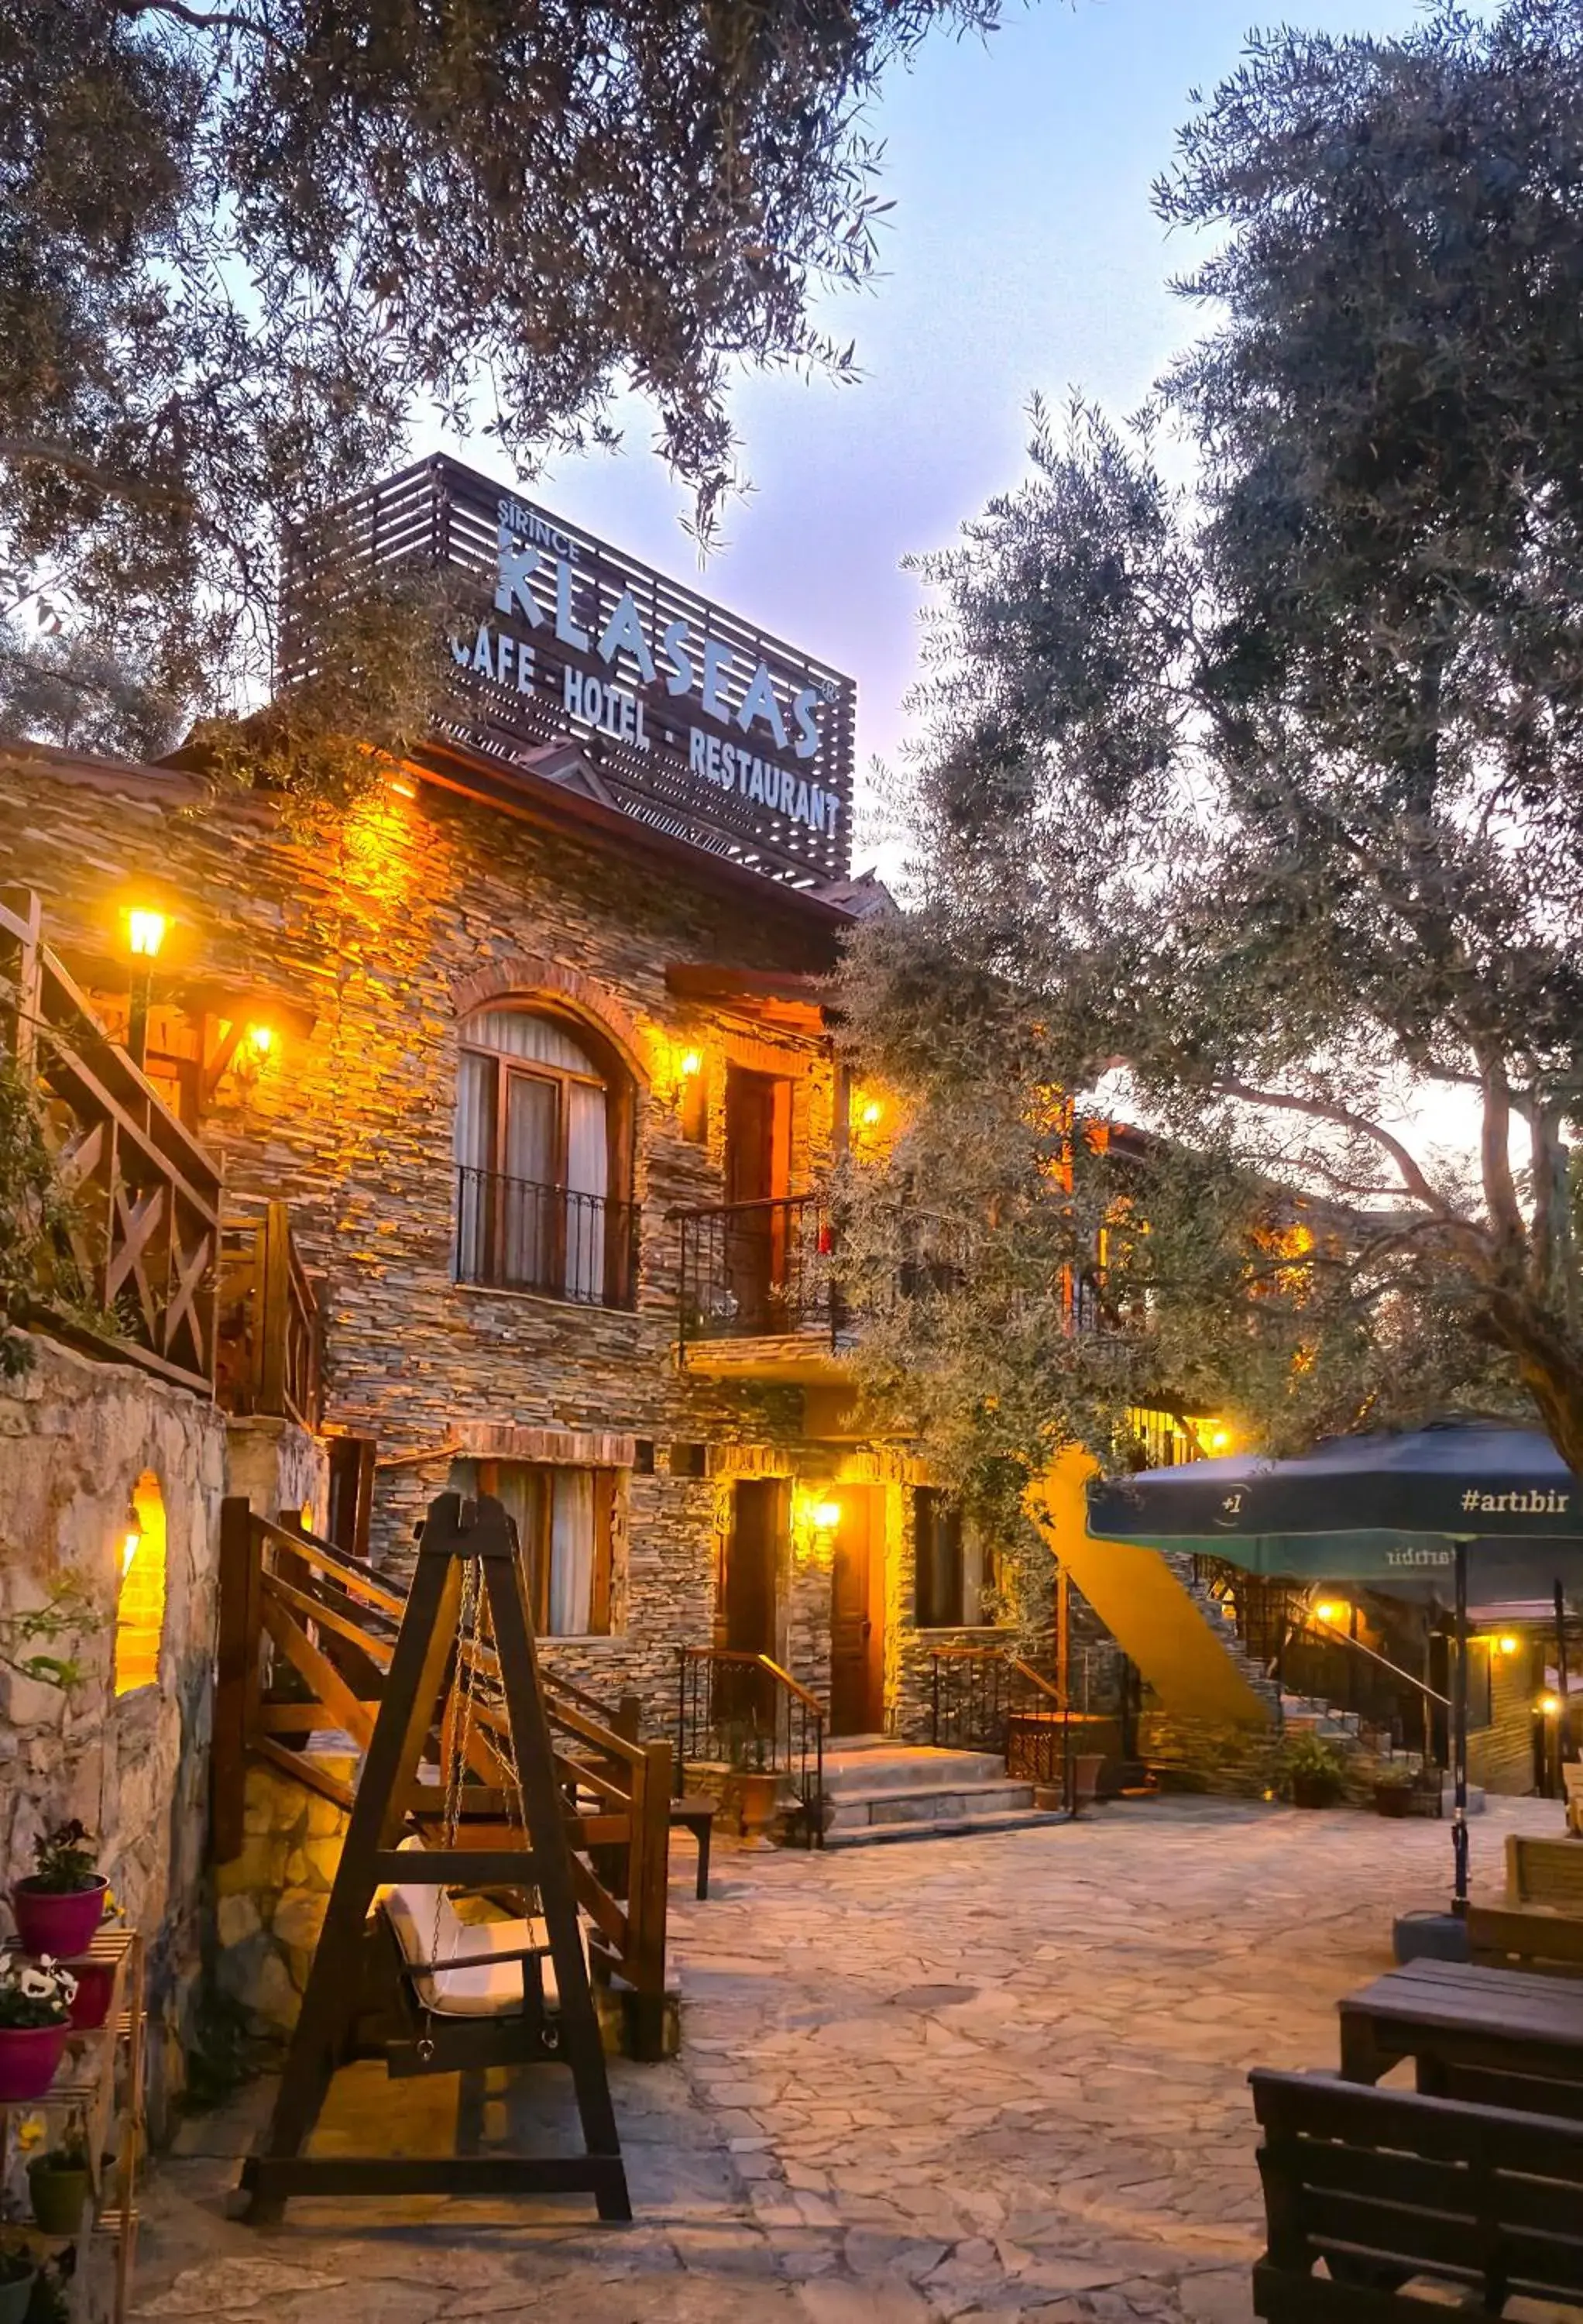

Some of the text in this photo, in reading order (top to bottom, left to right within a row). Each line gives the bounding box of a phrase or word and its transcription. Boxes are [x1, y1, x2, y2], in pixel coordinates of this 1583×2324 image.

[494, 525, 821, 759] KLASEAS
[563, 664, 650, 753] HOTEL
[689, 725, 840, 837] RESTAURANT
[1461, 1488, 1571, 1513] #artıbir
